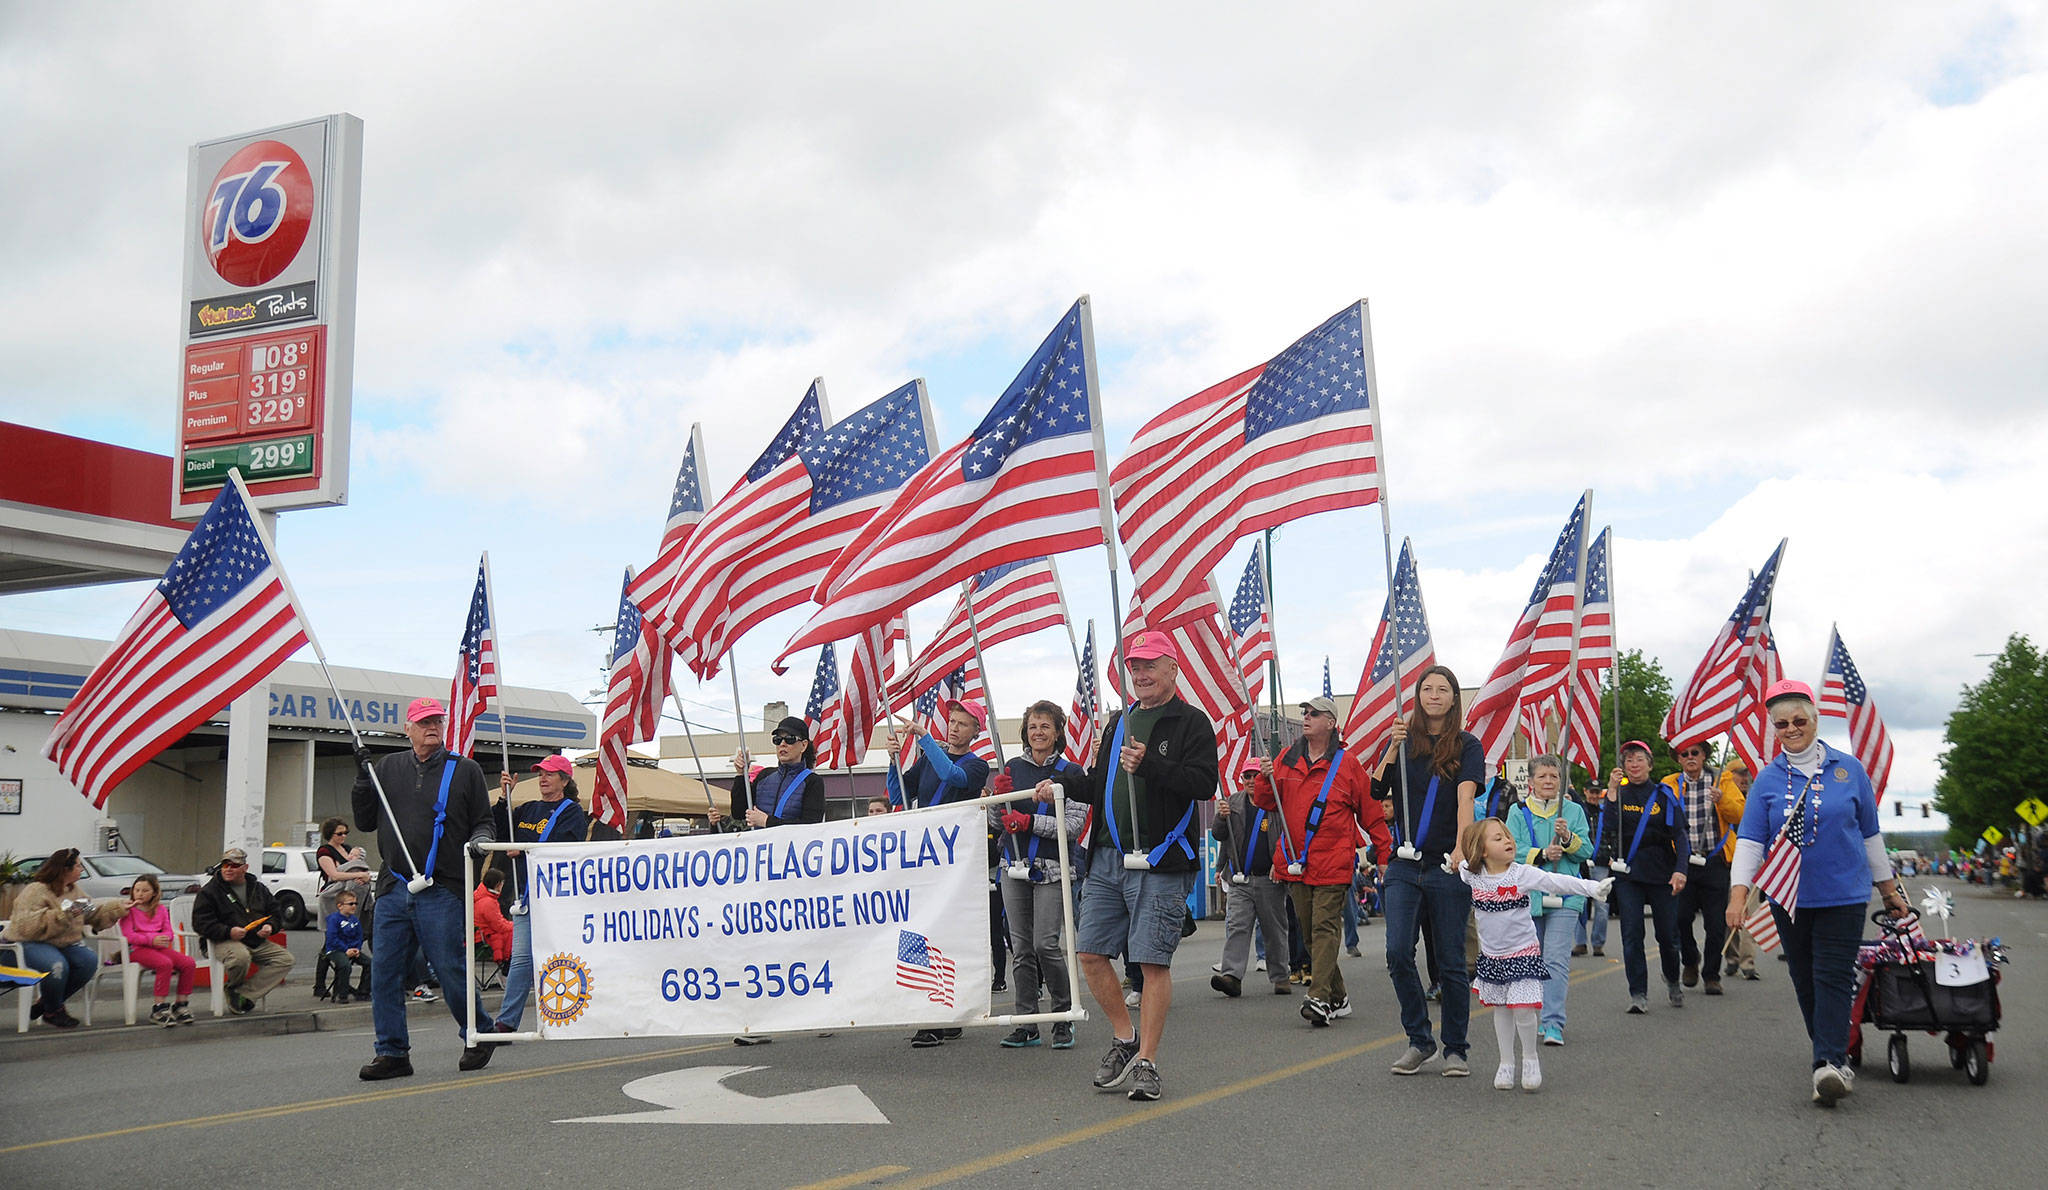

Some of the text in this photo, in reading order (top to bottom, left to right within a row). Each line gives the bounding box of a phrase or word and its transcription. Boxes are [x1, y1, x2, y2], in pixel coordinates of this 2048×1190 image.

[209, 161, 292, 254] 76
[256, 291, 307, 317] Points
[190, 361, 225, 375] Regular
[188, 391, 208, 401] Plus
[187, 415, 227, 428] Premium
[187, 459, 215, 471] Diesel
[269, 692, 399, 724] CAR WASH
[536, 824, 960, 899] NEIGHBORHOOD FLAG DISPLAY
[582, 913, 595, 944] 5
[603, 905, 700, 943] HOLIDAYS
[721, 895, 846, 936] SUBSCRIBE
[853, 889, 910, 926] NOW
[661, 959, 833, 1002] 683-3564
[1949, 963, 1960, 978] 3
